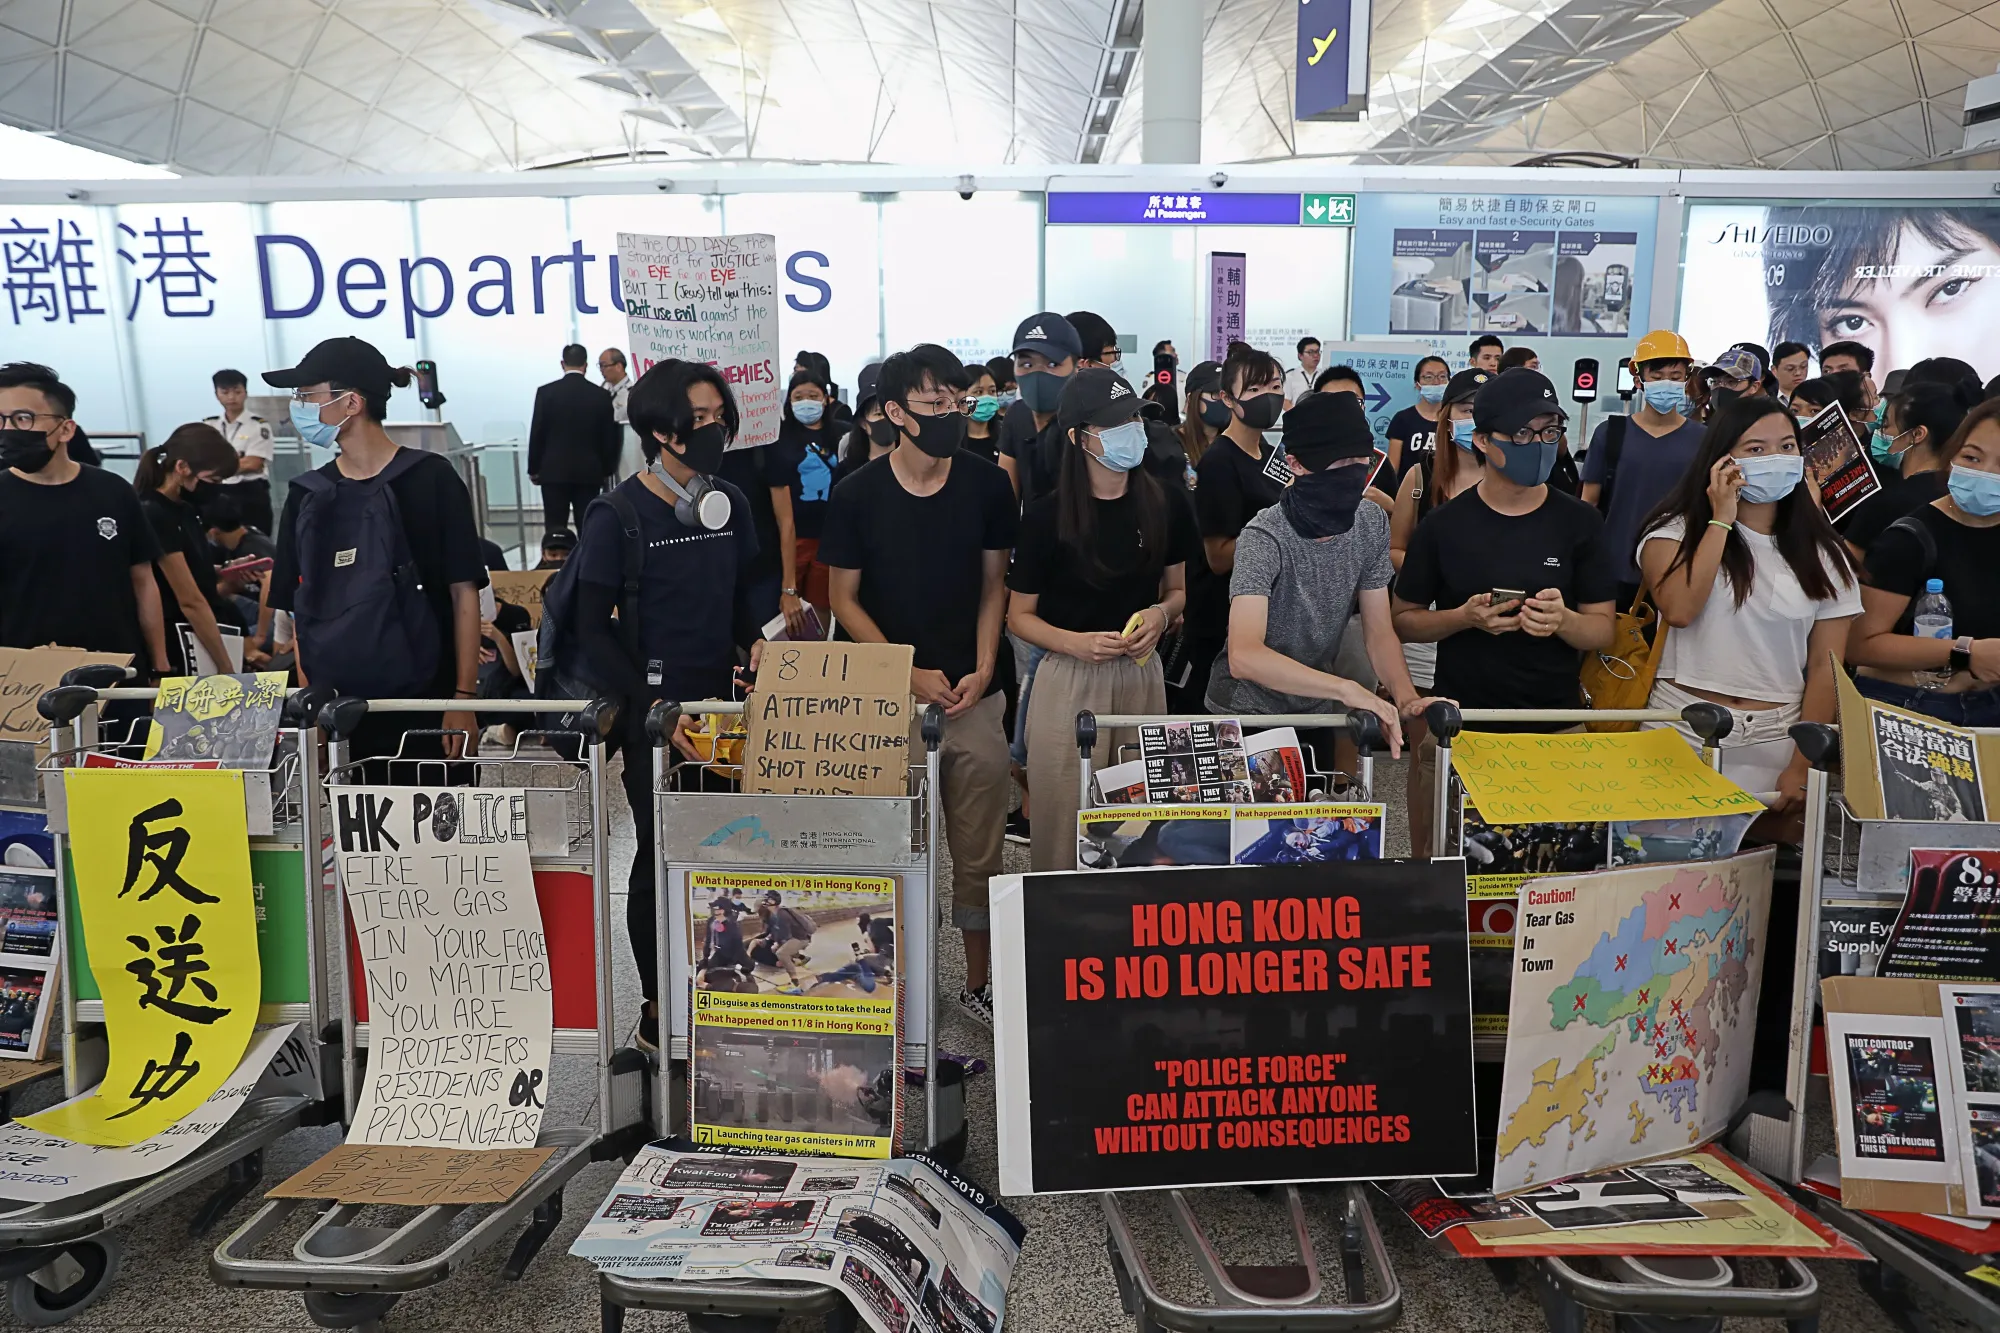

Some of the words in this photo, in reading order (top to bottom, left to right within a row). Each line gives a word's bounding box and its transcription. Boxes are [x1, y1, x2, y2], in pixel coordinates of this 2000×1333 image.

[1148, 195, 1202, 209] 所有旅客
[1143, 208, 1156, 218] All
[1158, 208, 1207, 220] Passengers
[1439, 215, 1463, 226] Easy
[1466, 216, 1486, 225] and
[1489, 216, 1507, 225] fast
[1510, 216, 1562, 228] e-Security
[1564, 217, 1595, 227] Gates
[1431, 230, 1437, 240] 1
[1512, 231, 1519, 241] 2
[1593, 233, 1601, 243] 3
[1708, 223, 1832, 245] SHISEIDO
[666, 236, 696, 254] OLD
[745, 236, 768, 249] the
[711, 254, 761, 268] JUSTICE
[0, 217, 216, 325] 離港
[648, 265, 672, 281] EYE
[256, 233, 833, 338] Departs
[624, 279, 648, 296] BUT
[724, 290, 740, 309] you
[701, 306, 740, 327] against
[747, 306, 768, 321] the
[631, 323, 652, 335] one
[653, 324, 673, 340] who
[688, 327, 734, 345] working
[739, 324, 760, 340] evil
[1386, 371, 1406, 379] Gates
[1110, 387, 1132, 400] adidas
[156, 678, 284, 713] 同舟共濟
[763, 694, 863, 720] ATTEMPT
[873, 698, 900, 717] TO
[1192, 724, 1209, 732] THEY
[764, 729, 806, 751] KILL
[1535, 736, 1628, 754] might
[757, 756, 806, 779] SHOT
[815, 759, 883, 781] BULLET
[1147, 759, 1165, 767] THEY
[1198, 756, 1215, 764] THEY
[1550, 760, 1604, 771] our
[1626, 757, 1684, 775] eye
[1640, 773, 1712, 790] still
[1151, 791, 1169, 799] THEY
[1202, 788, 1220, 796] THEY
[1103, 811, 1140, 819] happened
[1181, 809, 1200, 818] Hong
[1203, 809, 1222, 817] Kong
[1254, 809, 1291, 818] happened
[1488, 801, 1552, 818] can
[1568, 800, 1626, 817] see
[1627, 798, 1692, 813] the
[337, 793, 400, 853] HK
[413, 792, 526, 845] POLICE
[346, 856, 418, 887] FIRE
[431, 854, 503, 885] THE
[696, 876, 721, 885] What
[724, 877, 771, 887] happened
[791, 879, 811, 888] 11/8
[814, 880, 823, 888] in
[826, 880, 852, 891] Hong
[855, 881, 880, 892] Kong
[349, 889, 440, 922] TEAR
[453, 887, 508, 917] GAS
[1528, 888, 1576, 905] Caution!
[1132, 899, 1242, 948] HONG
[1253, 895, 1361, 942] KONG
[1525, 913, 1551, 927] Tear
[1555, 911, 1574, 925] Gas
[1829, 921, 1866, 934] Your
[361, 925, 406, 962] IN
[424, 924, 501, 962] YOUR
[503, 928, 547, 963] FACE
[1828, 939, 1885, 956] Supply
[105, 798, 232, 1120] 反送中
[1521, 958, 1553, 972] Town
[429, 962, 552, 996] MATTER
[1064, 956, 1104, 1001] IS
[1115, 953, 1169, 999] NO
[1180, 947, 1329, 997] LONGER
[1338, 944, 1432, 991] SAFE
[713, 998, 748, 1009] Disguise
[761, 1000, 824, 1011] demonstrators
[826, 1003, 834, 1011] to
[836, 1004, 854, 1013] take
[857, 1005, 871, 1013] the
[873, 1005, 891, 1014] lead
[379, 1002, 439, 1035] YOU
[454, 998, 513, 1030] ARE
[699, 1013, 723, 1023] What
[726, 1015, 773, 1026] happened
[776, 1018, 789, 1027] on
[792, 1018, 812, 1027] 11/8
[815, 1019, 824, 1028] in
[827, 1020, 852, 1031] Hong
[856, 1021, 881, 1032] Kong
[380, 1034, 529, 1071] PROTESTERS
[1848, 1038, 1868, 1048] RIOT
[1869, 1039, 1914, 1050] CONTROL?
[1155, 1055, 1252, 1088] "POLICE
[1258, 1052, 1347, 1085] FORCE"
[508, 1068, 545, 1109] OR
[1127, 1091, 1179, 1122] CAN
[1183, 1087, 1276, 1120] ATTACK
[1281, 1084, 1378, 1116] ANYONE
[365, 1103, 538, 1146] PASSENGERS
[717, 1129, 763, 1143] Launching
[765, 1134, 783, 1143] tear
[785, 1136, 800, 1145] gas
[802, 1136, 843, 1147] canisters
[845, 1138, 853, 1146] in
[855, 1139, 876, 1148] MTR
[1095, 1121, 1212, 1156] WIHTOUT
[1216, 1115, 1411, 1152] CONSEQUENCES
[1859, 1135, 1877, 1144] THIS
[1886, 1137, 1900, 1145] NOT
[1901, 1137, 1936, 1147] POLICING
[728, 1147, 779, 1156] Police
[1860, 1144, 1878, 1153] THIS
[705, 1171, 737, 1179] Fong
[949, 1175, 986, 1204] 2019
